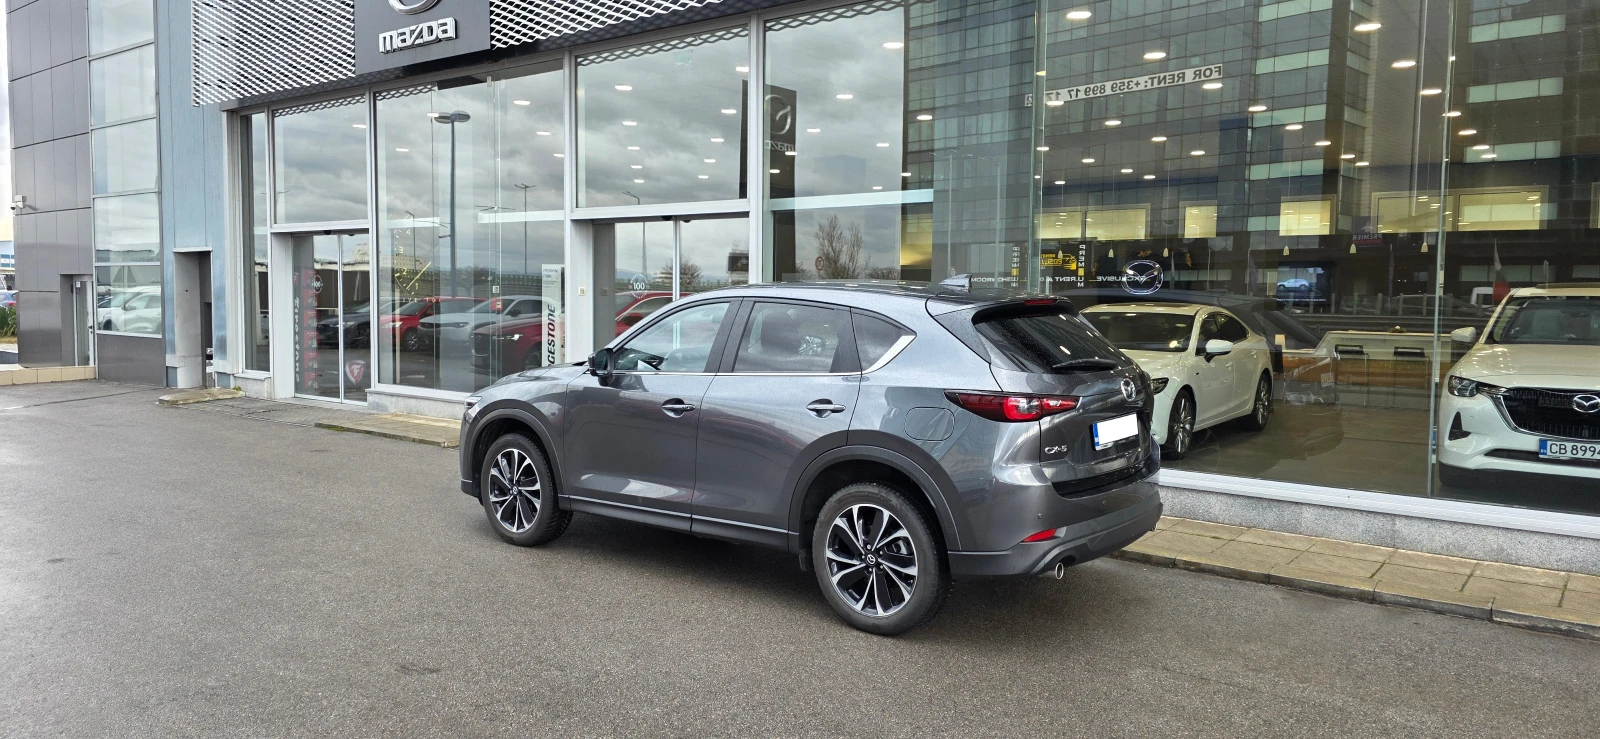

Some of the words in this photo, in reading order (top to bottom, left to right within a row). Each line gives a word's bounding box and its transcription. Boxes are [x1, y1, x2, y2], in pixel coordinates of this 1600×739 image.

[379, 17, 456, 54] mazda
[632, 282, 645, 290] 100
[547, 304, 556, 366] GESTONE
[1044, 444, 1068, 455] CX-5
[1549, 443, 1568, 455] CB
